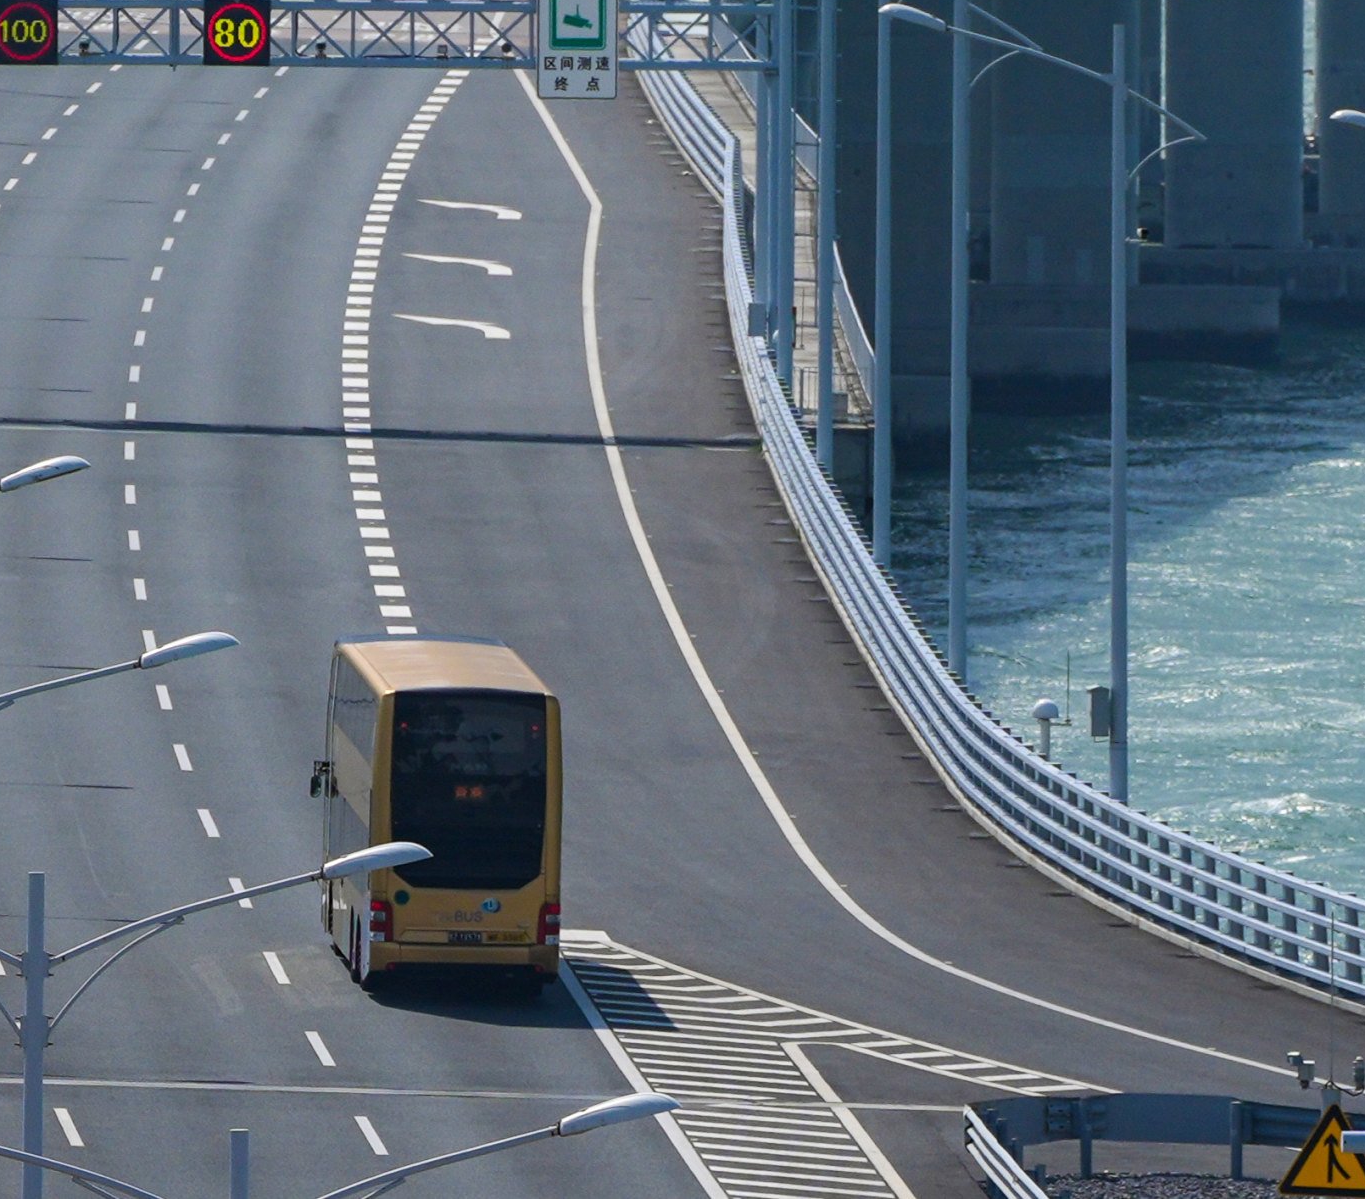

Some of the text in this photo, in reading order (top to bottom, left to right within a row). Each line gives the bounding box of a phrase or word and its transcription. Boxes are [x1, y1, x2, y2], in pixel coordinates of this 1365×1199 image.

[0, 20, 48, 43] 100
[213, 18, 261, 48] 80
[544, 56, 610, 71] 区间测速
